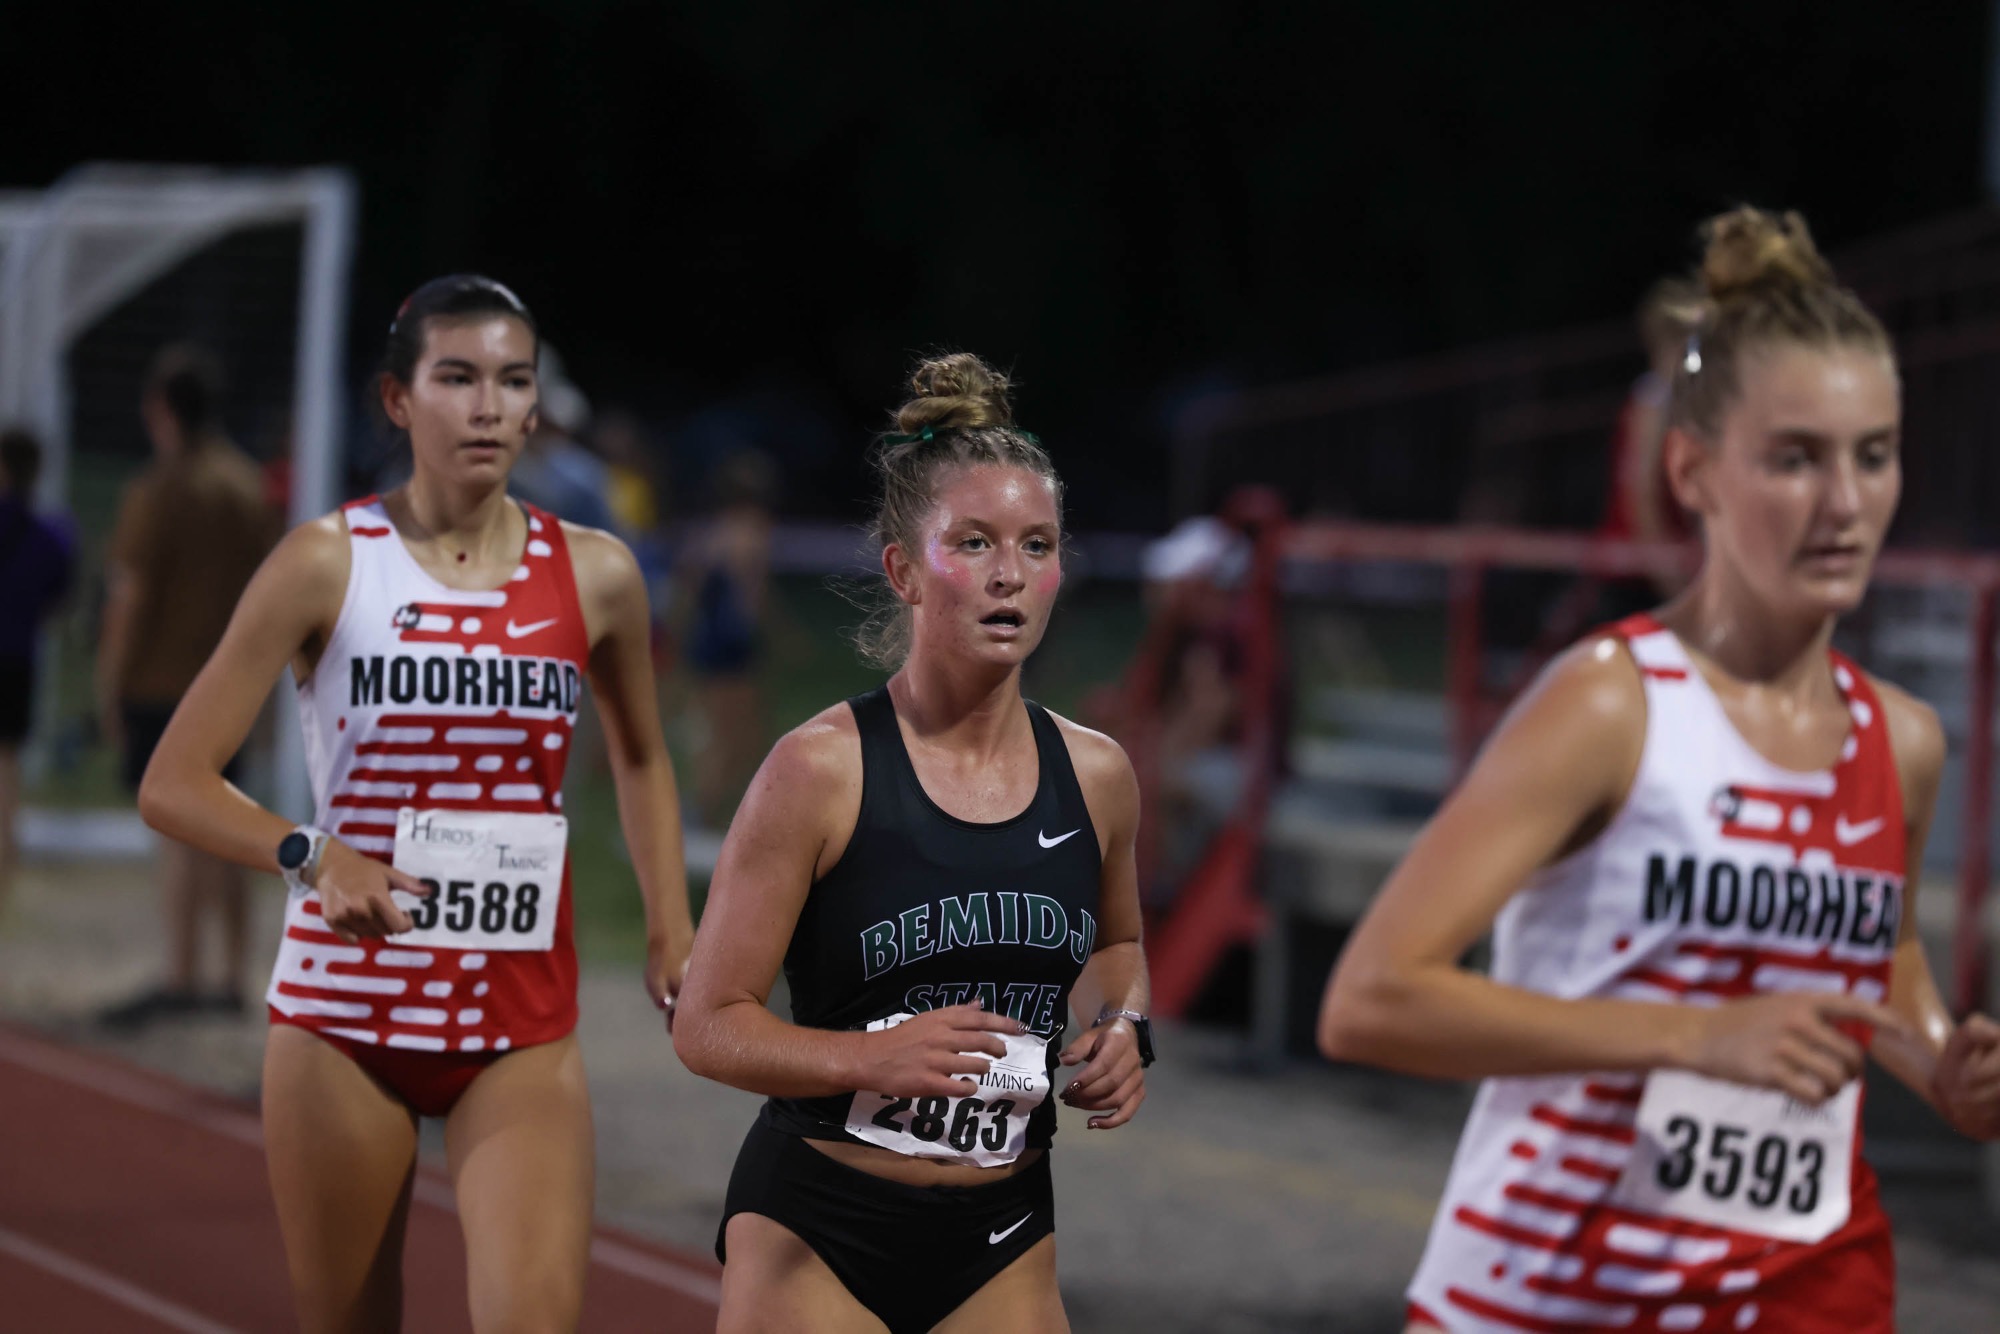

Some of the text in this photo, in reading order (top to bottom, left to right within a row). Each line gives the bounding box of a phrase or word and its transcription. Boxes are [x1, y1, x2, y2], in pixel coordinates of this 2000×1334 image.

[351, 656, 580, 714] MOORHEAD
[496, 844, 548, 870] TIMING
[411, 877, 541, 934] 3588
[1645, 855, 1899, 949] MOORHEA
[860, 892, 1097, 982] BEMIDJ
[871, 1095, 1016, 1153] 2863
[1657, 1114, 1825, 1216] 3593
